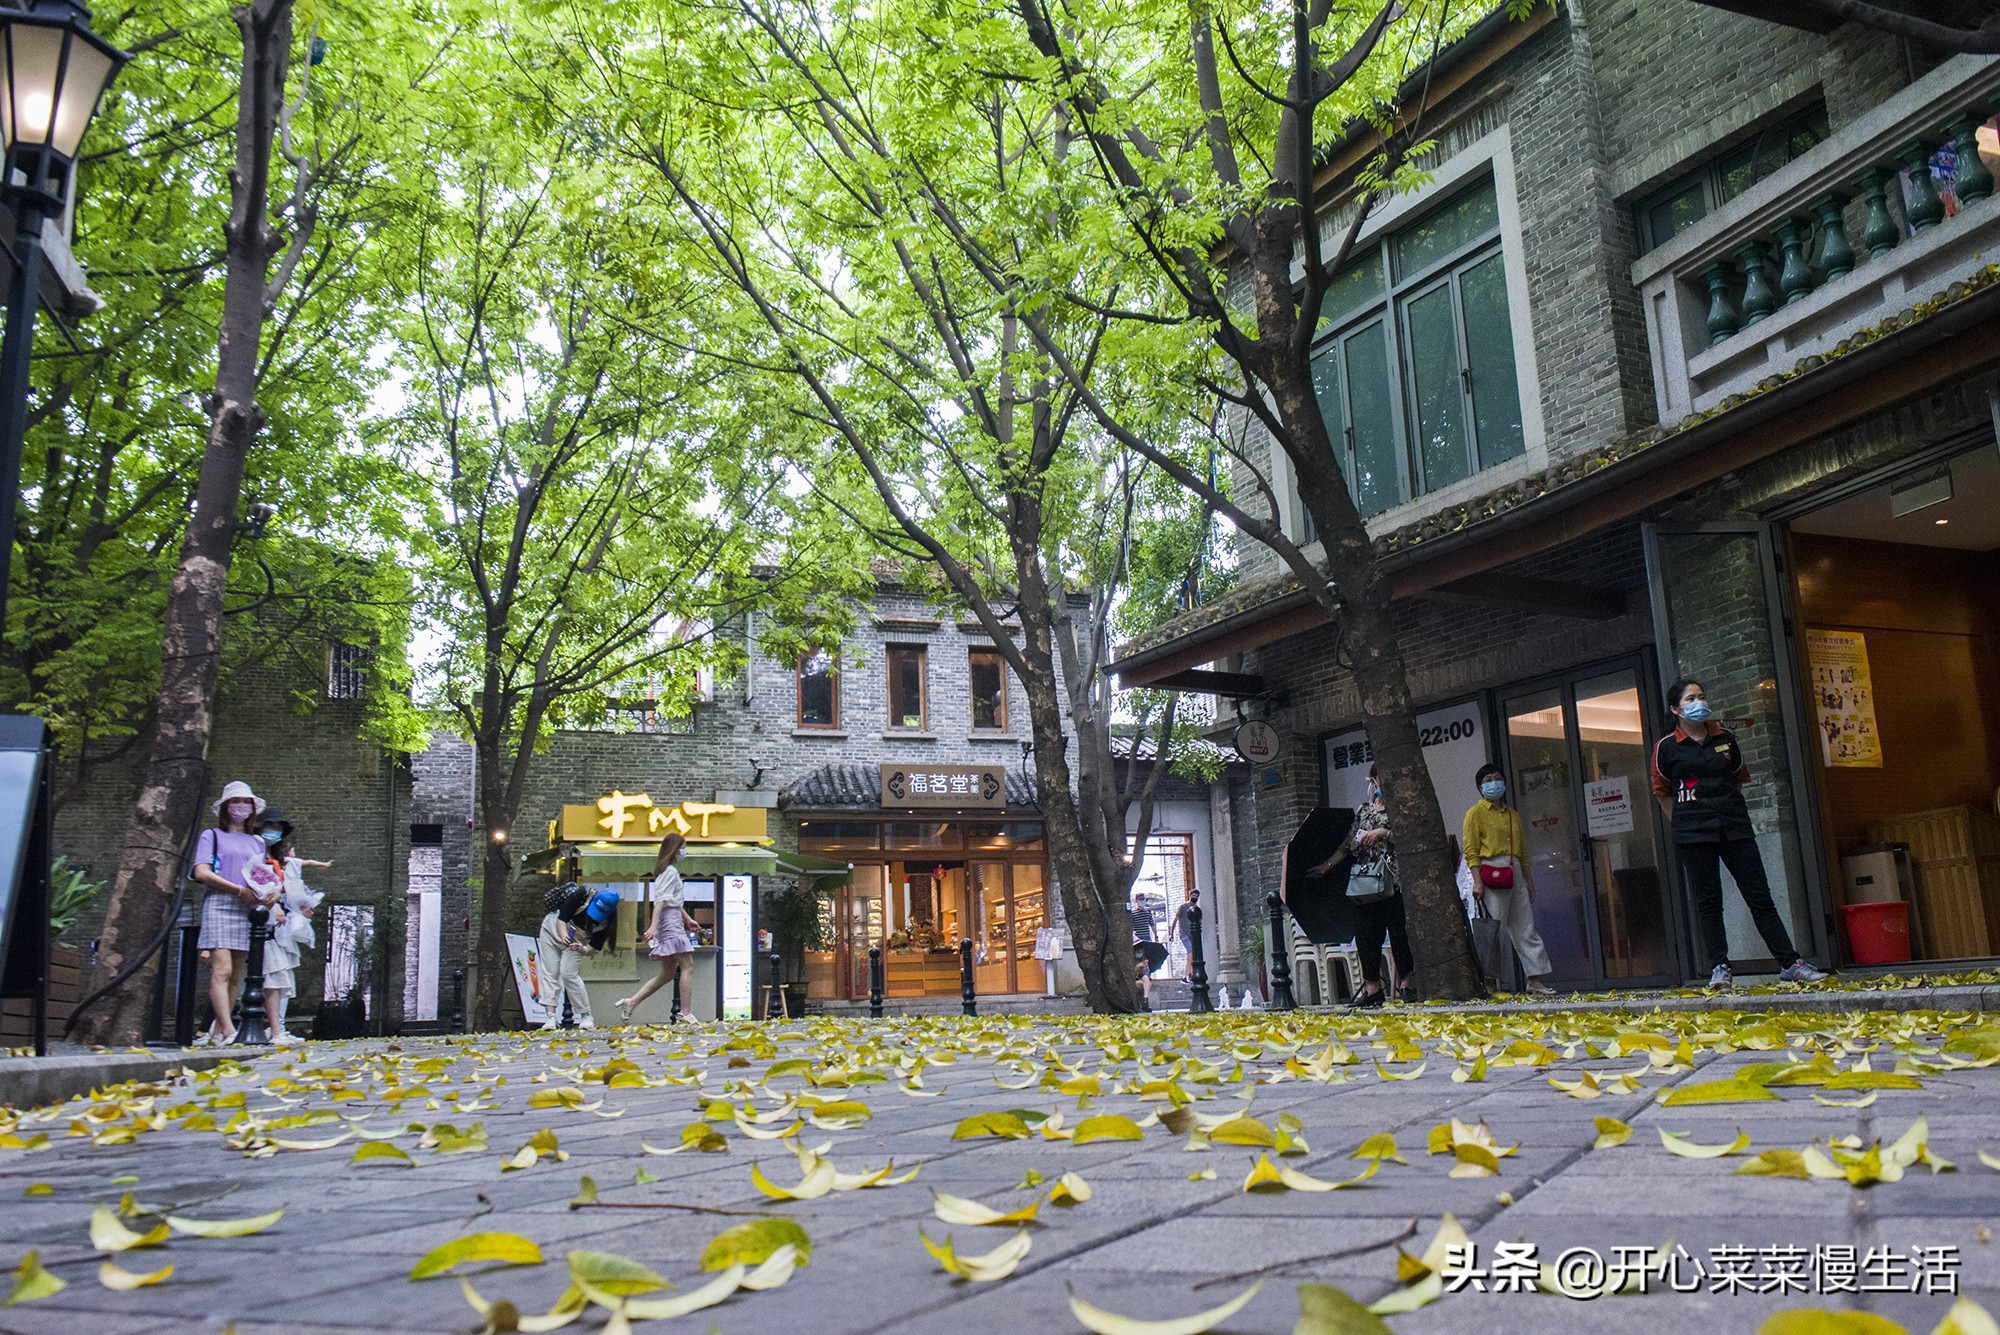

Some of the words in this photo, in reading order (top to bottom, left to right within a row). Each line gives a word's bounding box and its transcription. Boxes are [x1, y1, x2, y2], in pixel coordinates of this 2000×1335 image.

[1420, 719, 1475, 748] 22:00
[909, 773, 968, 793] 福茗堂
[597, 790, 735, 838] FMT
